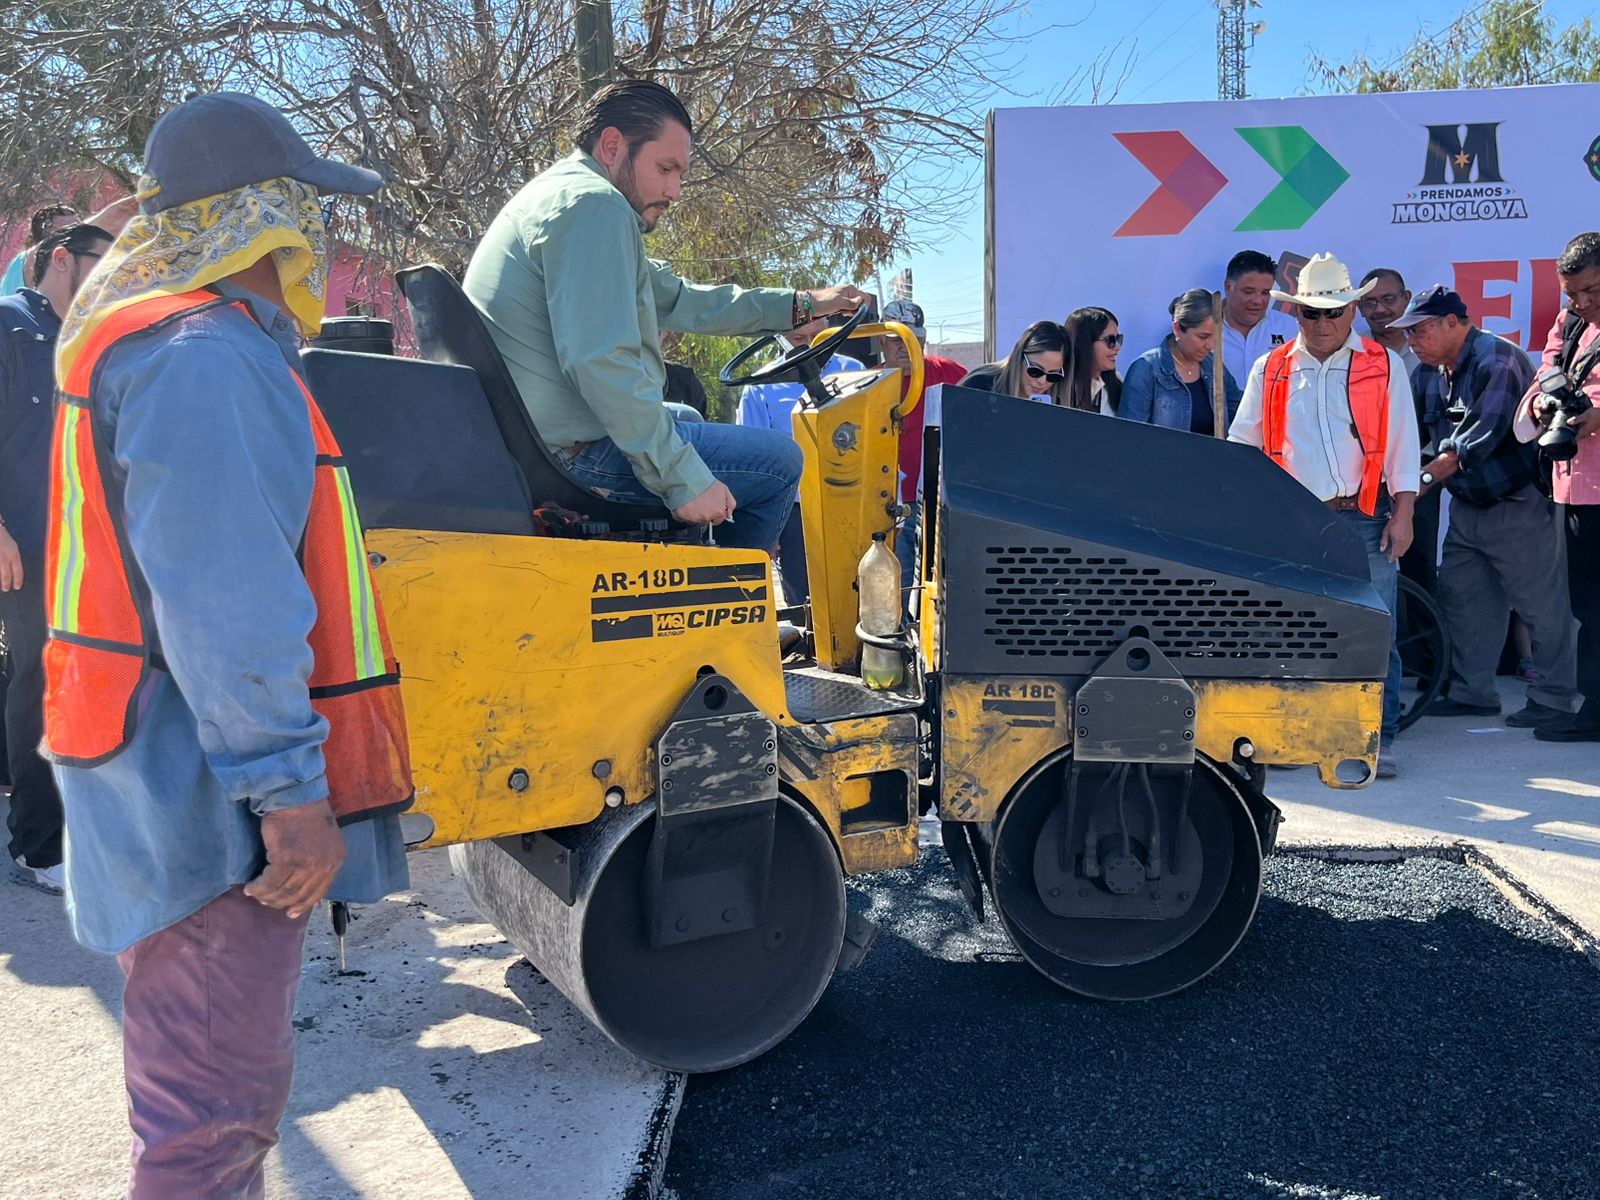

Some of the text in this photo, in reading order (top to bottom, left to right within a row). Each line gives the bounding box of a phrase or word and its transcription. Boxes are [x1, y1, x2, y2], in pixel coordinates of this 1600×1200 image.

[1417, 120, 1507, 186] M
[1420, 187, 1503, 200] PRENDAMOS
[1391, 198, 1528, 224] MONCLOVA
[592, 568, 685, 593] AR-18D
[687, 605, 766, 629] CIPSA
[983, 683, 1011, 698] AR
